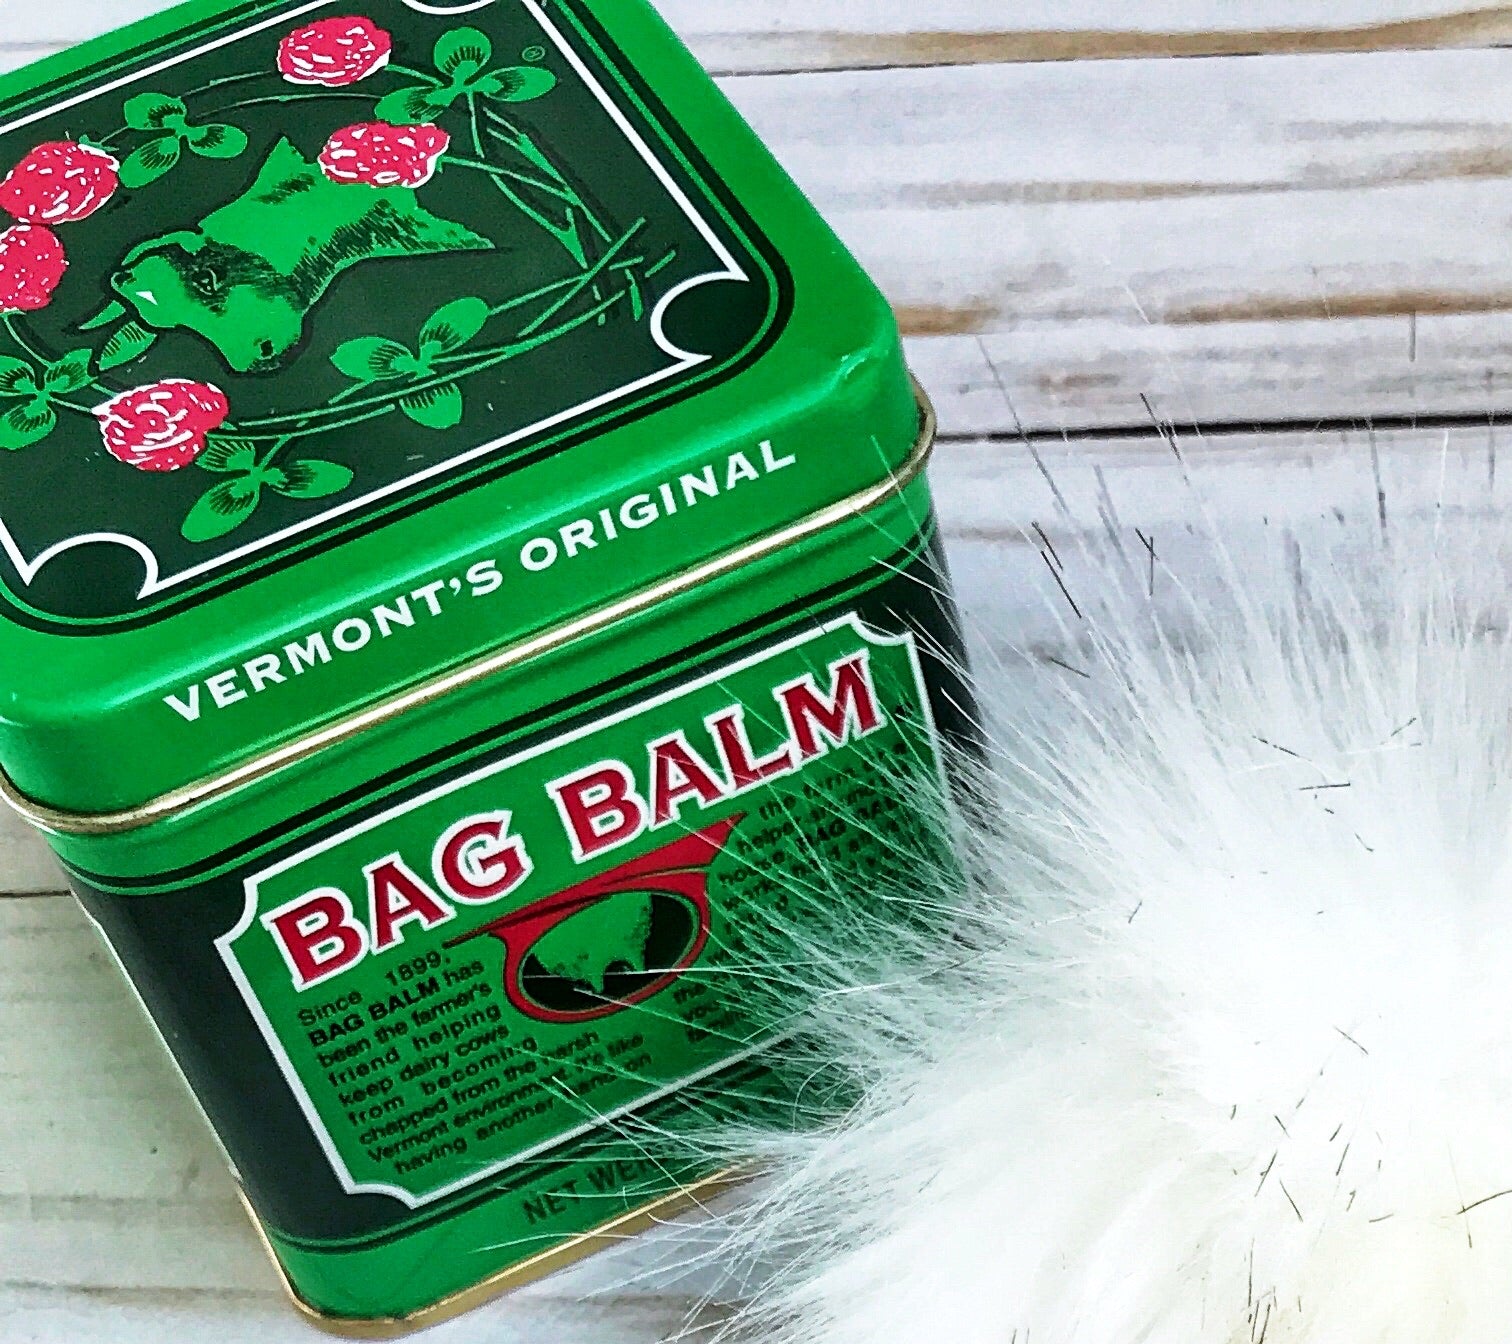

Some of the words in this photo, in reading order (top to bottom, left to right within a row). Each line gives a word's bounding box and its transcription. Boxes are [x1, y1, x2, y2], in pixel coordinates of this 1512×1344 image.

[164, 560, 504, 724] VERMONT'S
[519, 438, 798, 573] ORIGINAL
[262, 809, 534, 990] BAG
[547, 649, 887, 864] BALM
[297, 991, 362, 1026] Since
[308, 1014, 364, 1047] BAG
[368, 976, 440, 1020] BALM
[442, 961, 484, 986] has
[317, 1038, 371, 1068] been
[374, 1022, 408, 1043] the
[411, 983, 492, 1027] farmer's
[329, 1047, 400, 1087] friend
[412, 1005, 501, 1051] helping
[338, 1077, 393, 1107] keep
[399, 1052, 449, 1081] dairy
[455, 1025, 509, 1056] cows
[348, 1096, 404, 1126] from
[420, 1037, 537, 1095] becoming
[360, 1097, 448, 1152] chapped
[452, 1077, 500, 1105] from
[503, 1061, 536, 1082] the
[368, 1120, 449, 1162] Vermont
[394, 1137, 467, 1174] having
[476, 1097, 553, 1140] another
[523, 1181, 586, 1224] NET
